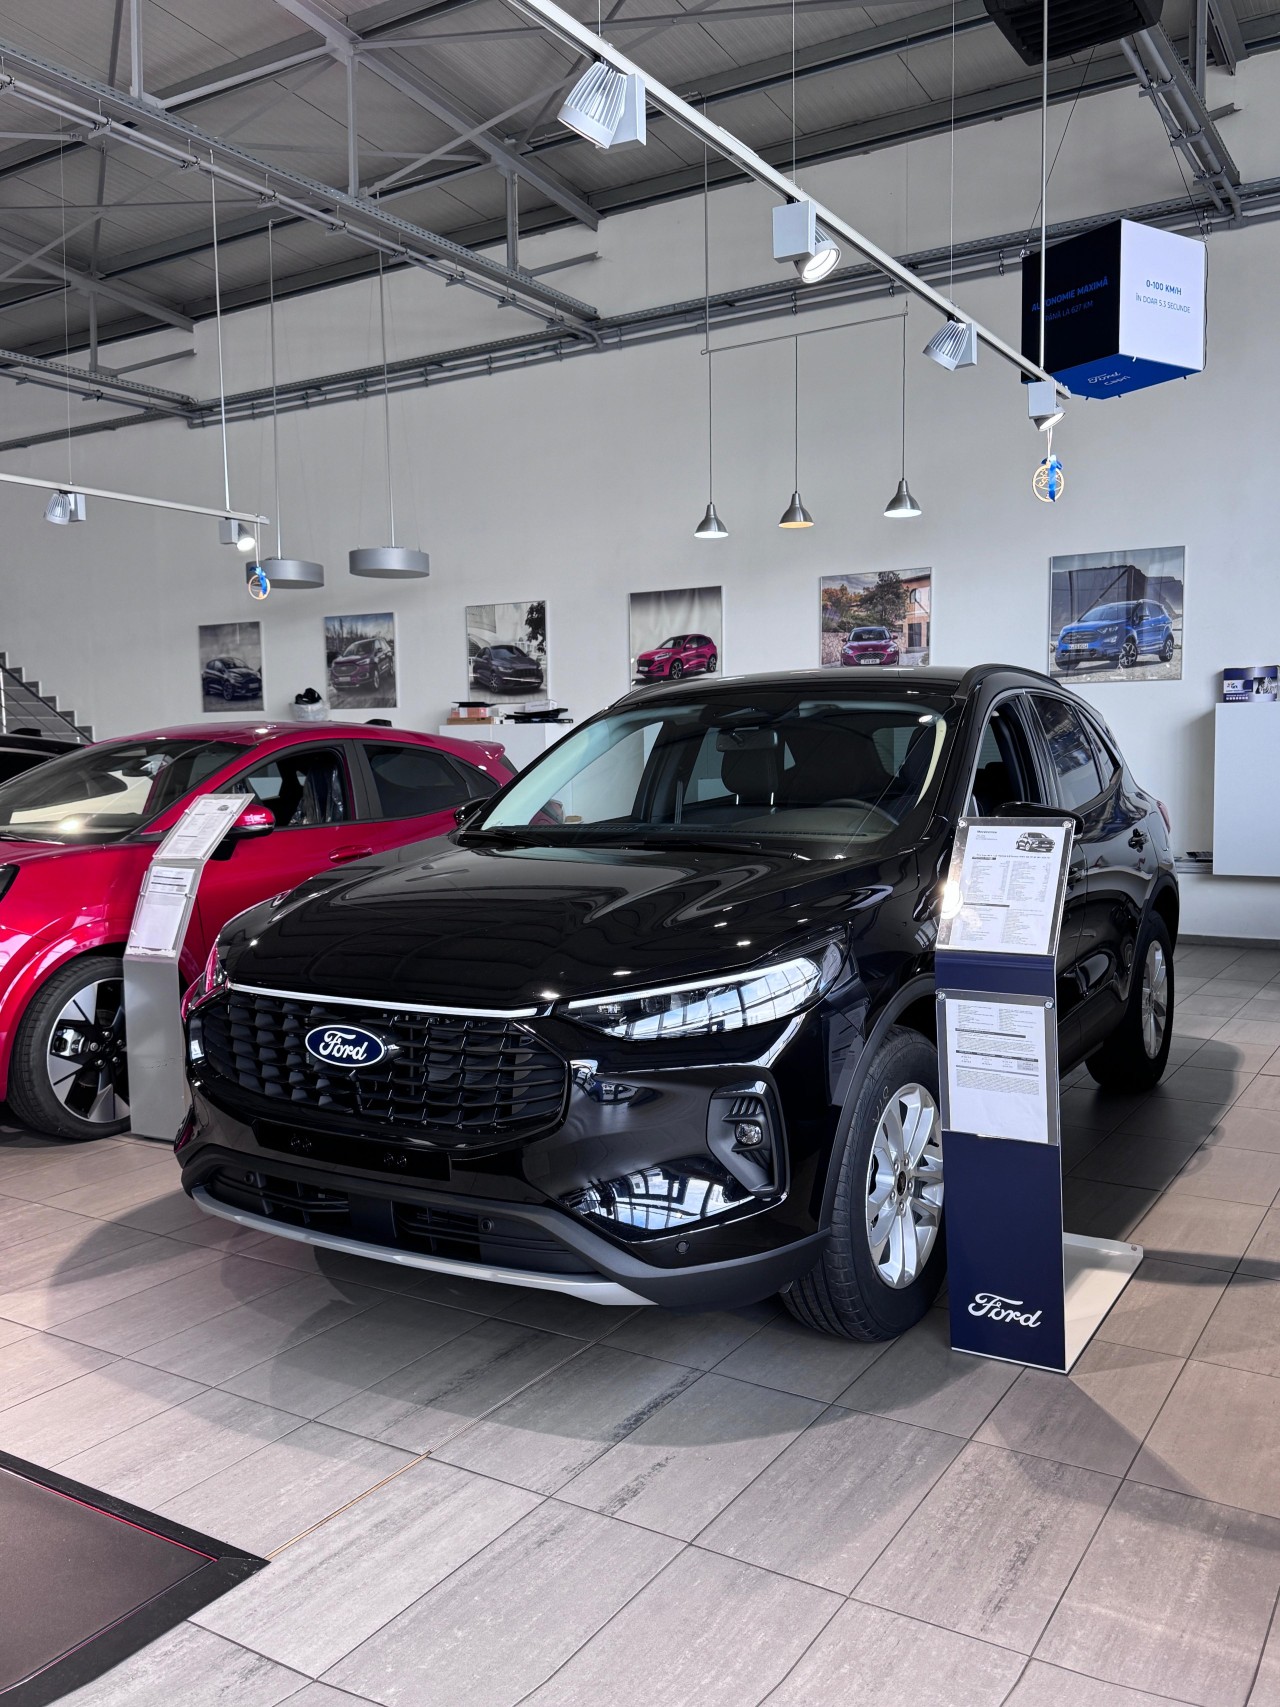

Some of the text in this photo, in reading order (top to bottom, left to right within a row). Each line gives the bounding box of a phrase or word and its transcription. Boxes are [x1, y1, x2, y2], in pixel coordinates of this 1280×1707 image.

[1146, 280, 1182, 295] 0-100 KM/H
[1143, 296, 1157, 304] DOAR
[1167, 302, 1190, 313] SECUNDE
[1088, 372, 1121, 383] Ford
[319, 1030, 368, 1060] Ford
[968, 1293, 1042, 1327] Ford
